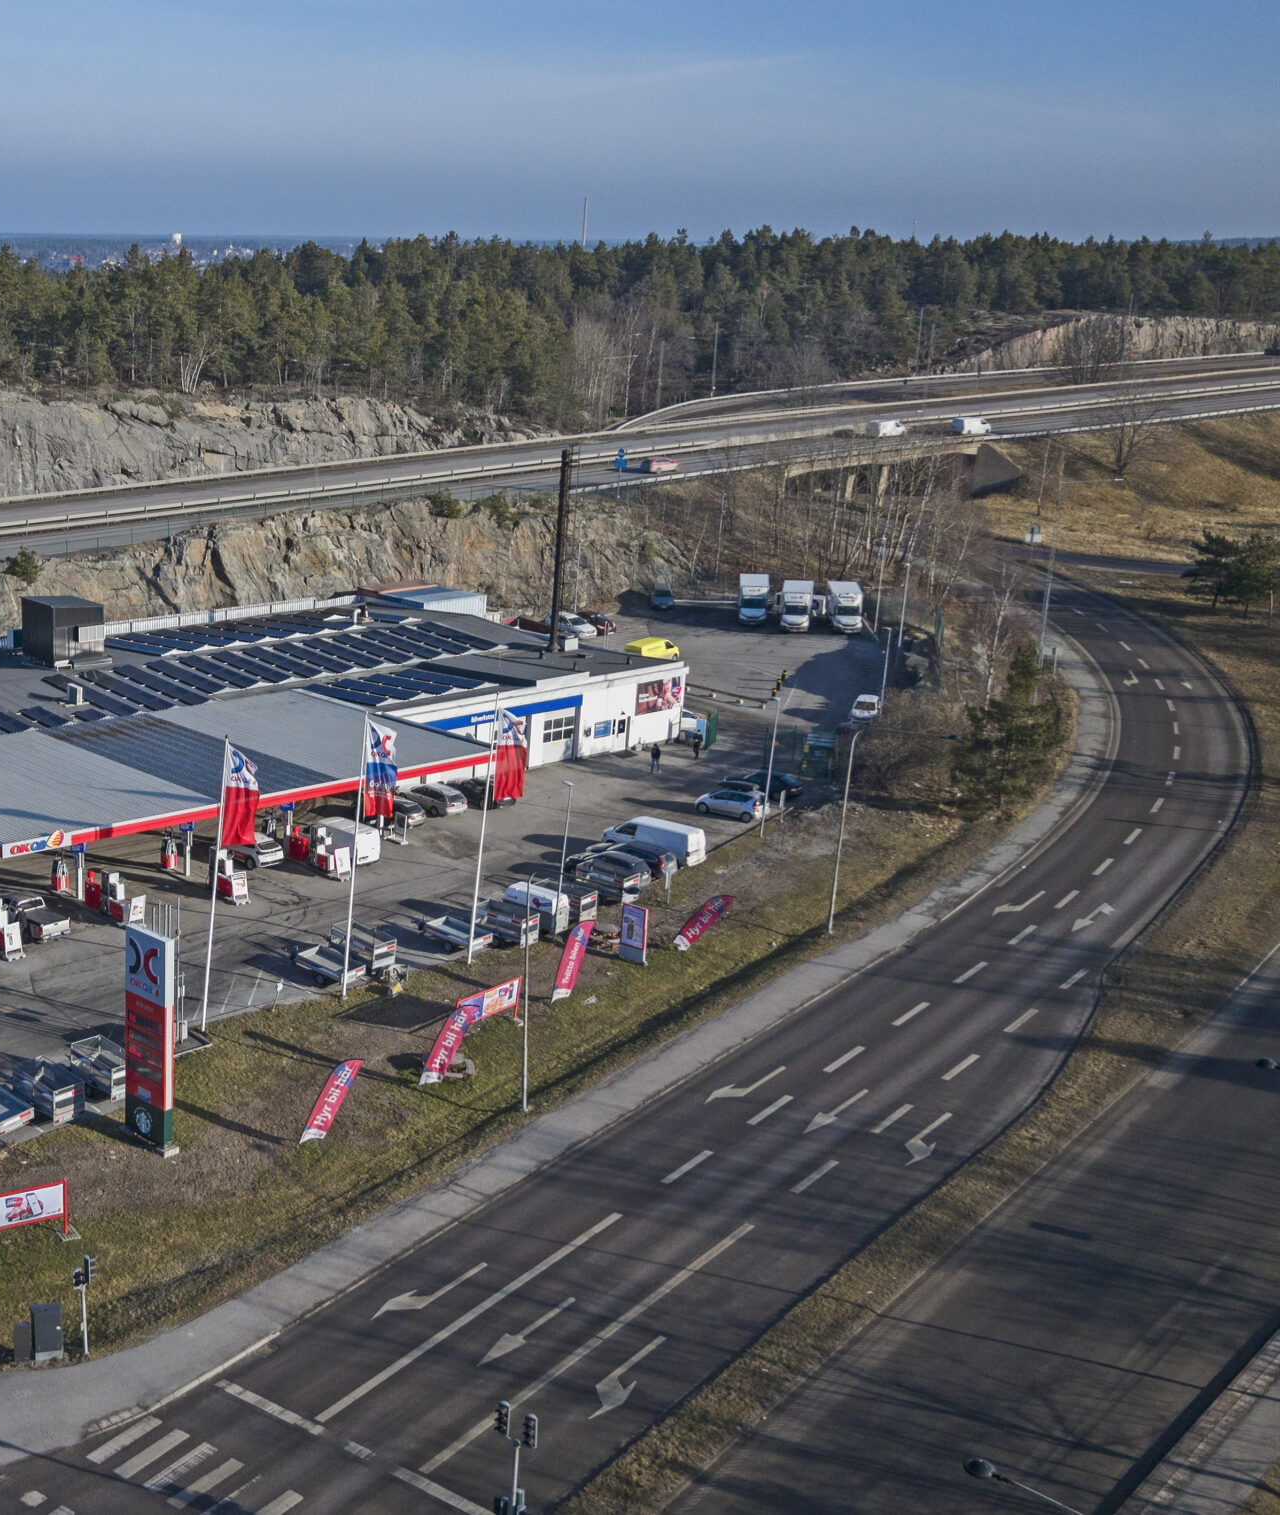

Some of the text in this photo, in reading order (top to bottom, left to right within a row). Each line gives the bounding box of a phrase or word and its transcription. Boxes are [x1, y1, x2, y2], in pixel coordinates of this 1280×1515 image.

[575, 928, 585, 941] här
[686, 922, 703, 939] Hyr
[699, 911, 713, 924] bil
[568, 942, 580, 960] bilen
[562, 961, 575, 984] Tvätta
[432, 1011, 468, 1070] Hyr bil här
[313, 1104, 332, 1126] Hyr
[325, 1087, 341, 1103] bil
[333, 1066, 353, 1087] här
